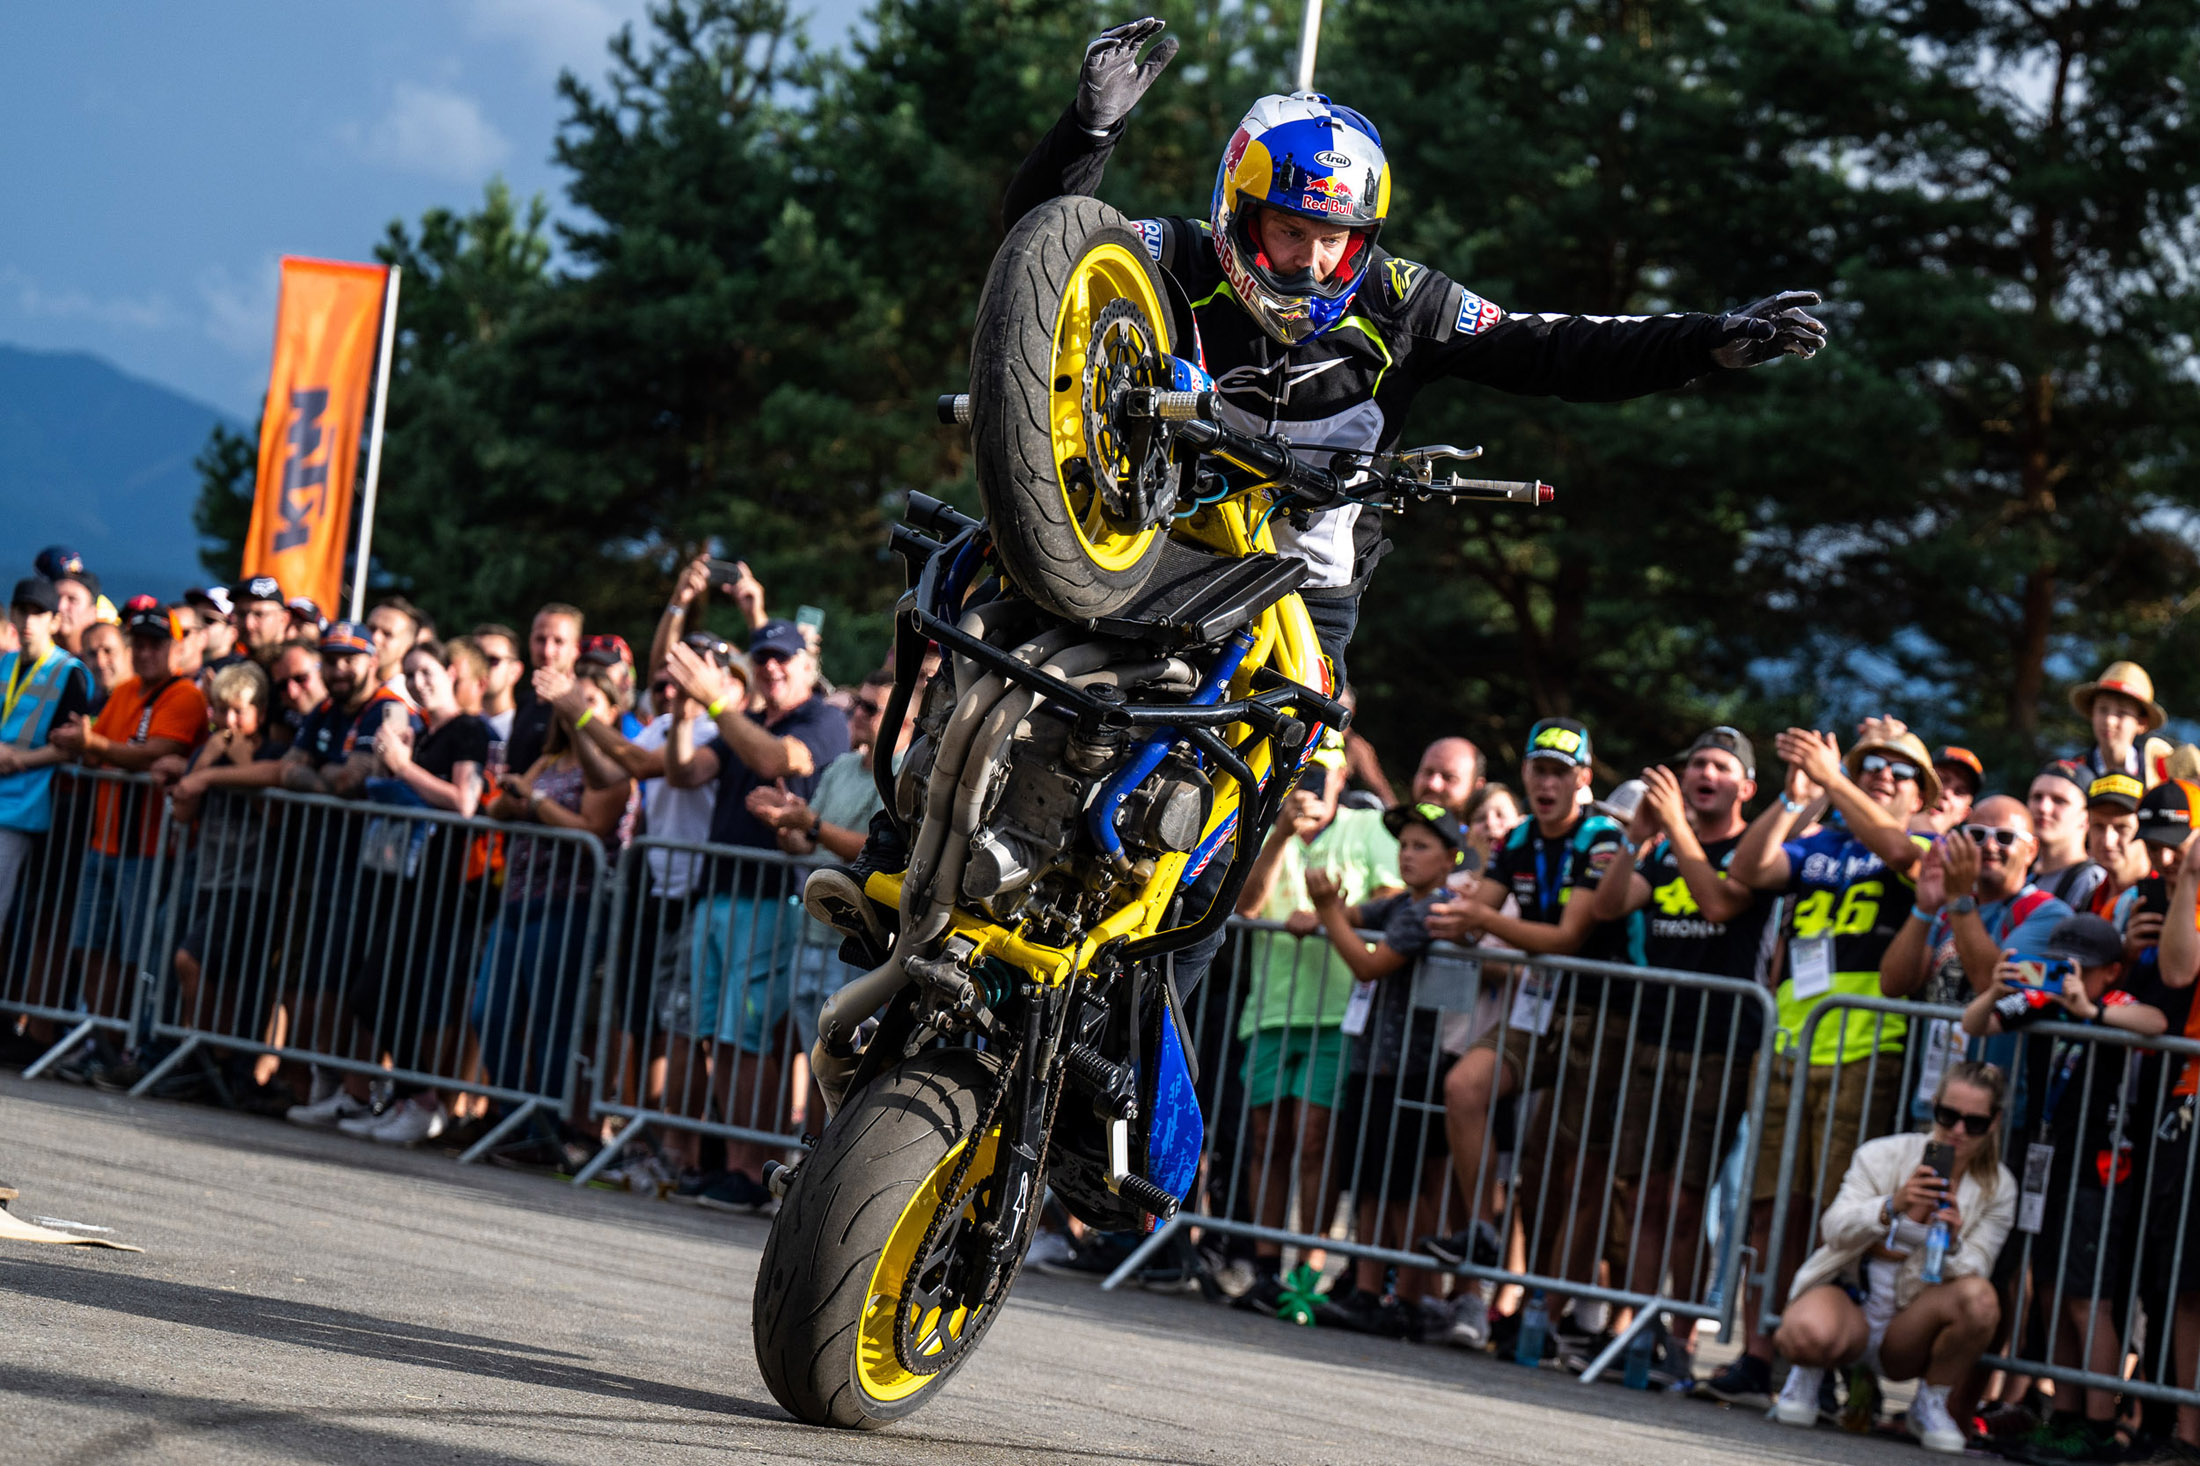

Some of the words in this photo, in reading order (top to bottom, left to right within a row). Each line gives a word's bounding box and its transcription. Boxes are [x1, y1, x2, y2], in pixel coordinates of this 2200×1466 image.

[1318, 153, 1347, 165] Arai
[1302, 194, 1330, 212] Red
[1330, 198, 1354, 216] Bull
[1220, 244, 1258, 302] Bull
[1654, 875, 1700, 915] 4
[1793, 881, 1884, 938] 46
